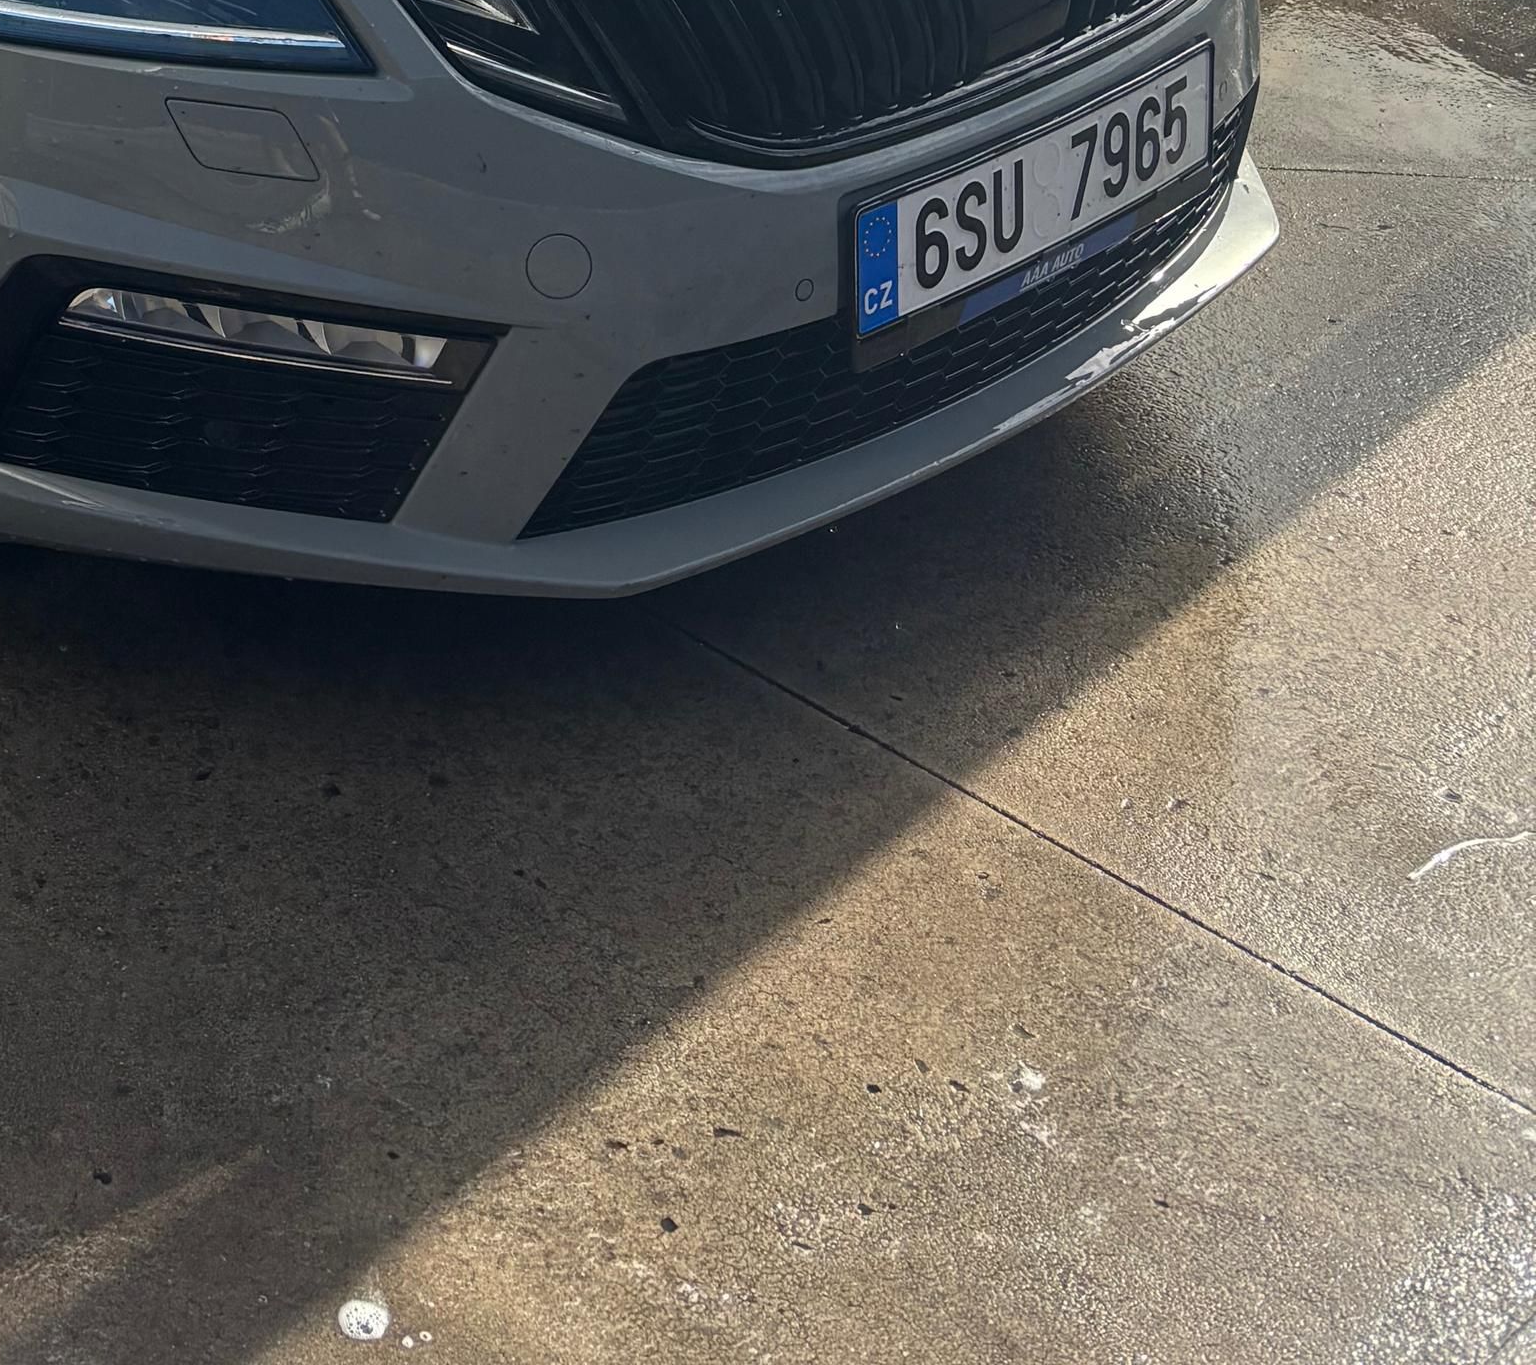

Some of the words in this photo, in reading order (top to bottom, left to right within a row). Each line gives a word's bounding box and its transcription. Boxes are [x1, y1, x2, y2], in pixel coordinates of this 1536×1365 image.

[915, 159, 1025, 290] 6SU
[1070, 75, 1188, 222] 7965
[1020, 261, 1049, 288] AAA
[1051, 242, 1085, 272] AUTO
[864, 281, 893, 316] CZ
